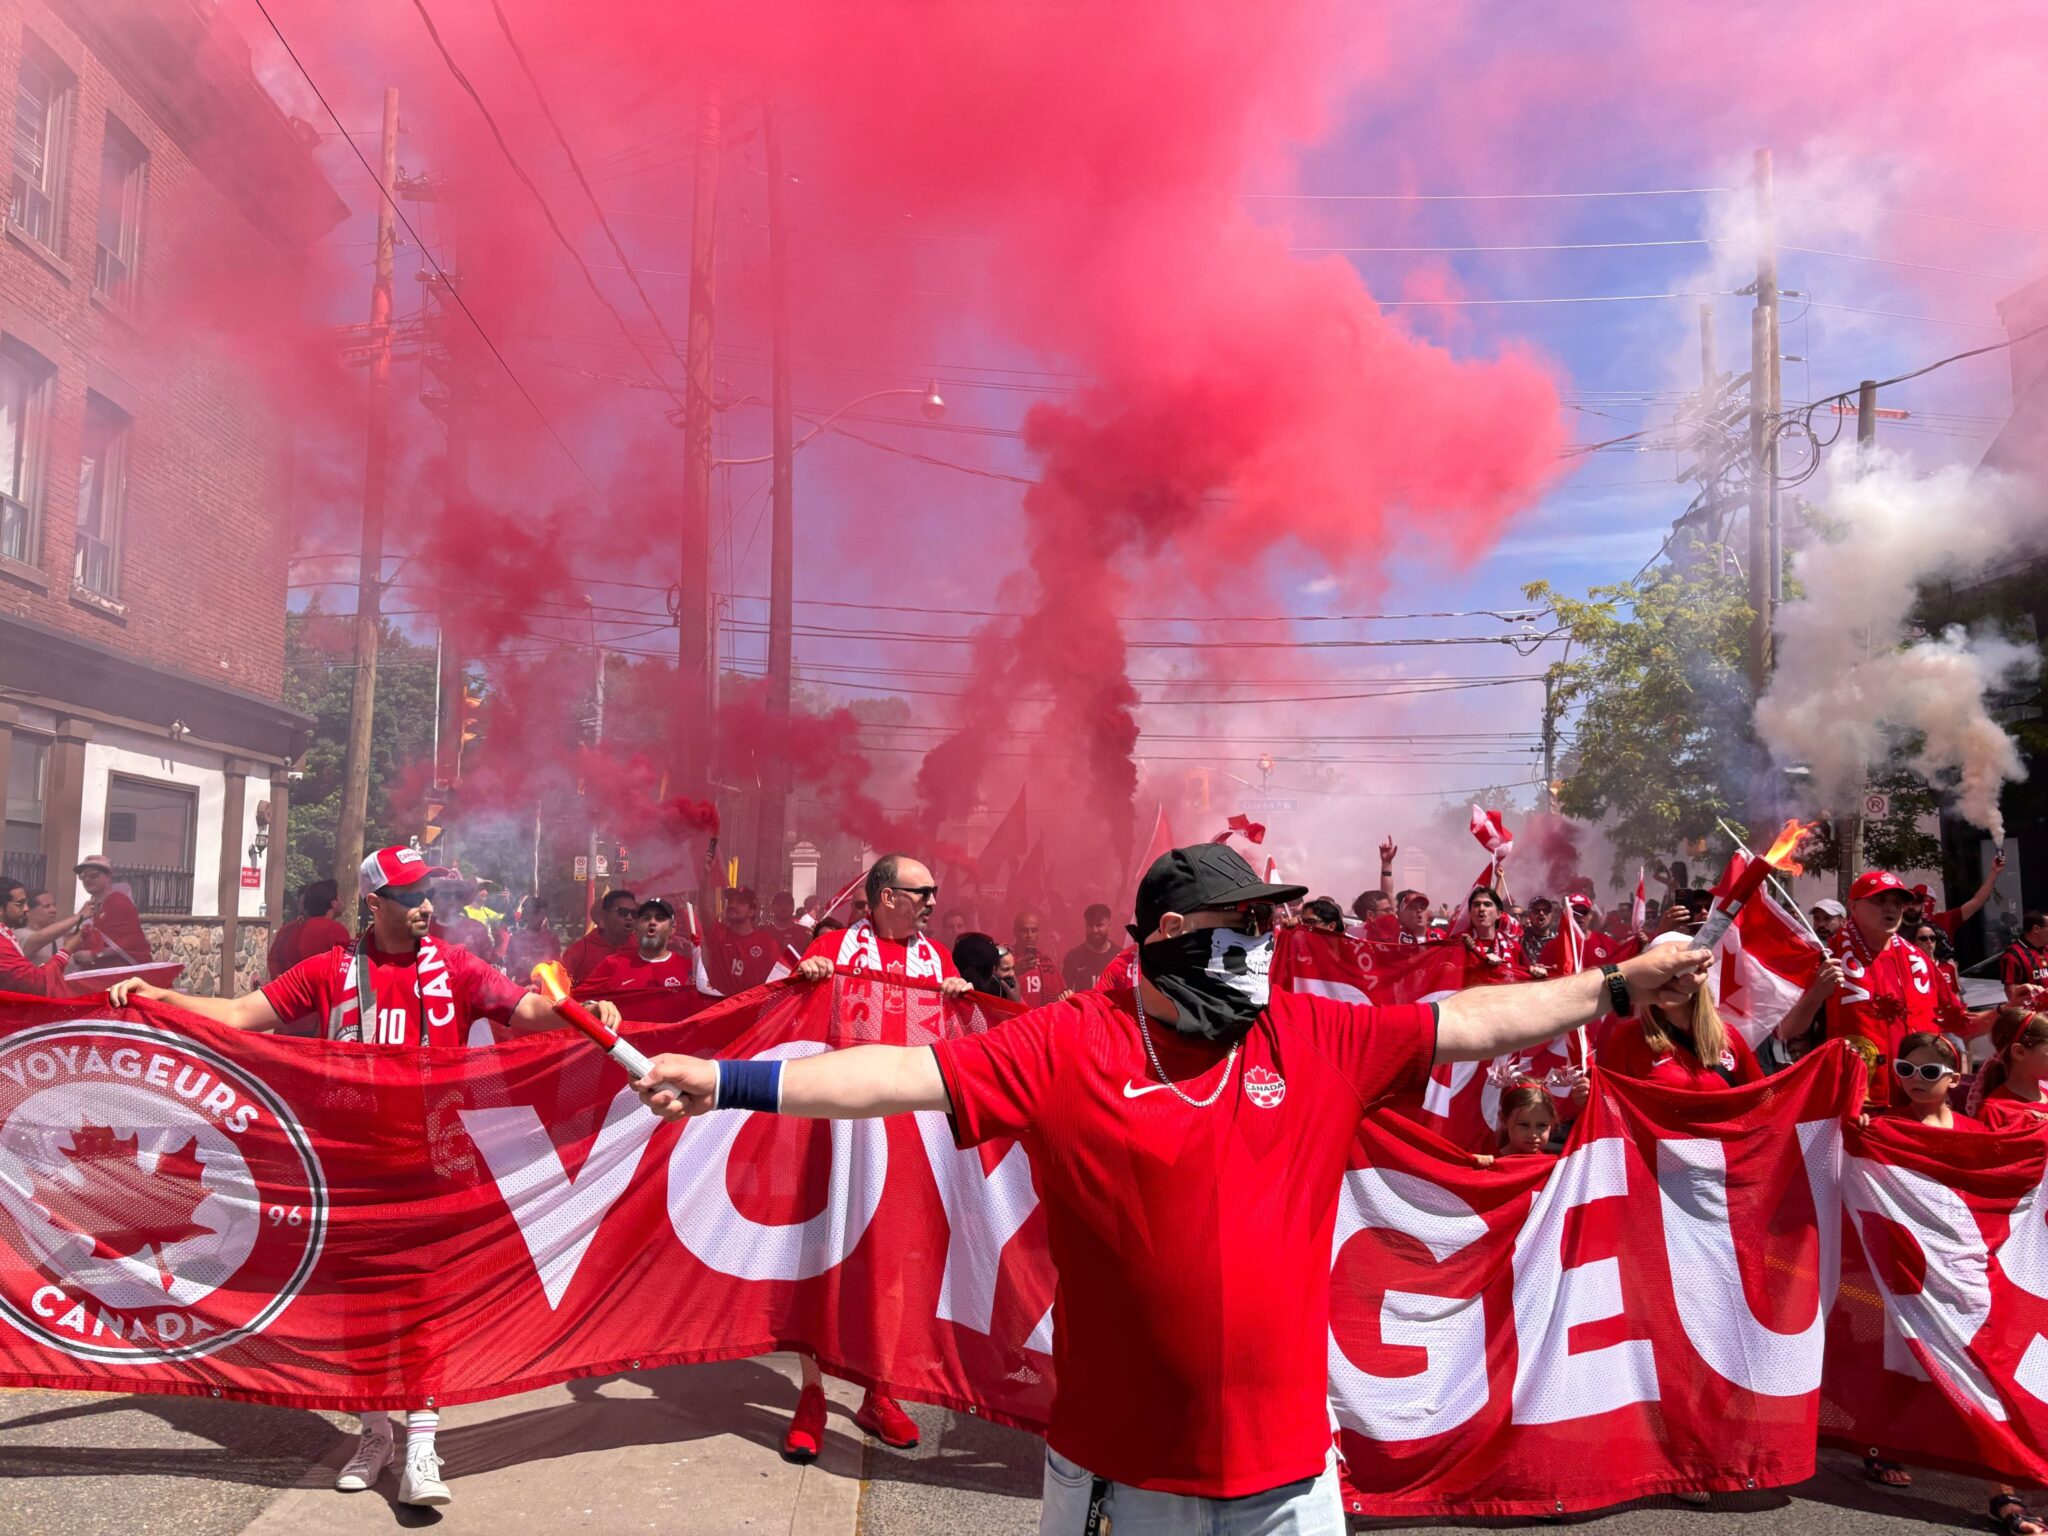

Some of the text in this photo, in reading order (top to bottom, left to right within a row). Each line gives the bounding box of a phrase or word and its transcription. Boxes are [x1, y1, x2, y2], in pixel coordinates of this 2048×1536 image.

[339, 961, 350, 973] 25
[731, 958, 744, 976] 19
[418, 936, 455, 1027] CAN
[1026, 975, 1041, 993] 19
[378, 1008, 406, 1044] 10
[1, 1045, 259, 1134] VOYAGEURS
[1245, 1082, 1284, 1092] CANADA
[268, 1206, 303, 1227] 96
[31, 1285, 214, 1342] CANADA
